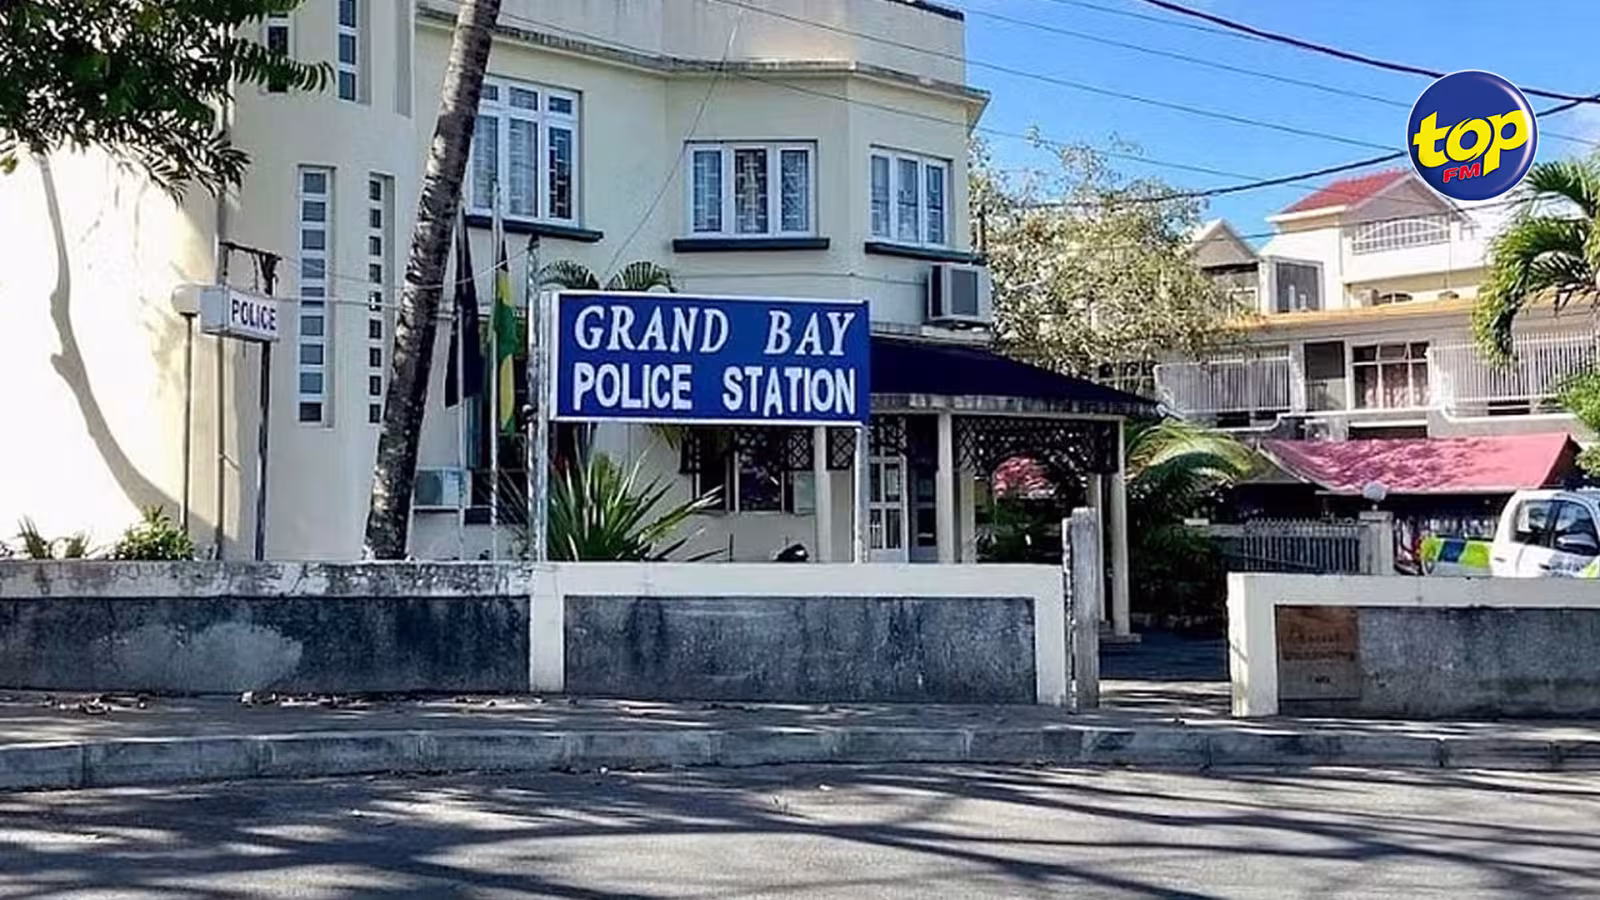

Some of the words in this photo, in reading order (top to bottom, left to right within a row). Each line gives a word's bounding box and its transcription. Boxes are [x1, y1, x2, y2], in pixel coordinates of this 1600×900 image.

[231, 298, 276, 331] POLICE
[574, 305, 729, 353] GRAND
[763, 309, 856, 356] BAY
[573, 361, 693, 411] POLICE
[722, 365, 856, 417] STATION
